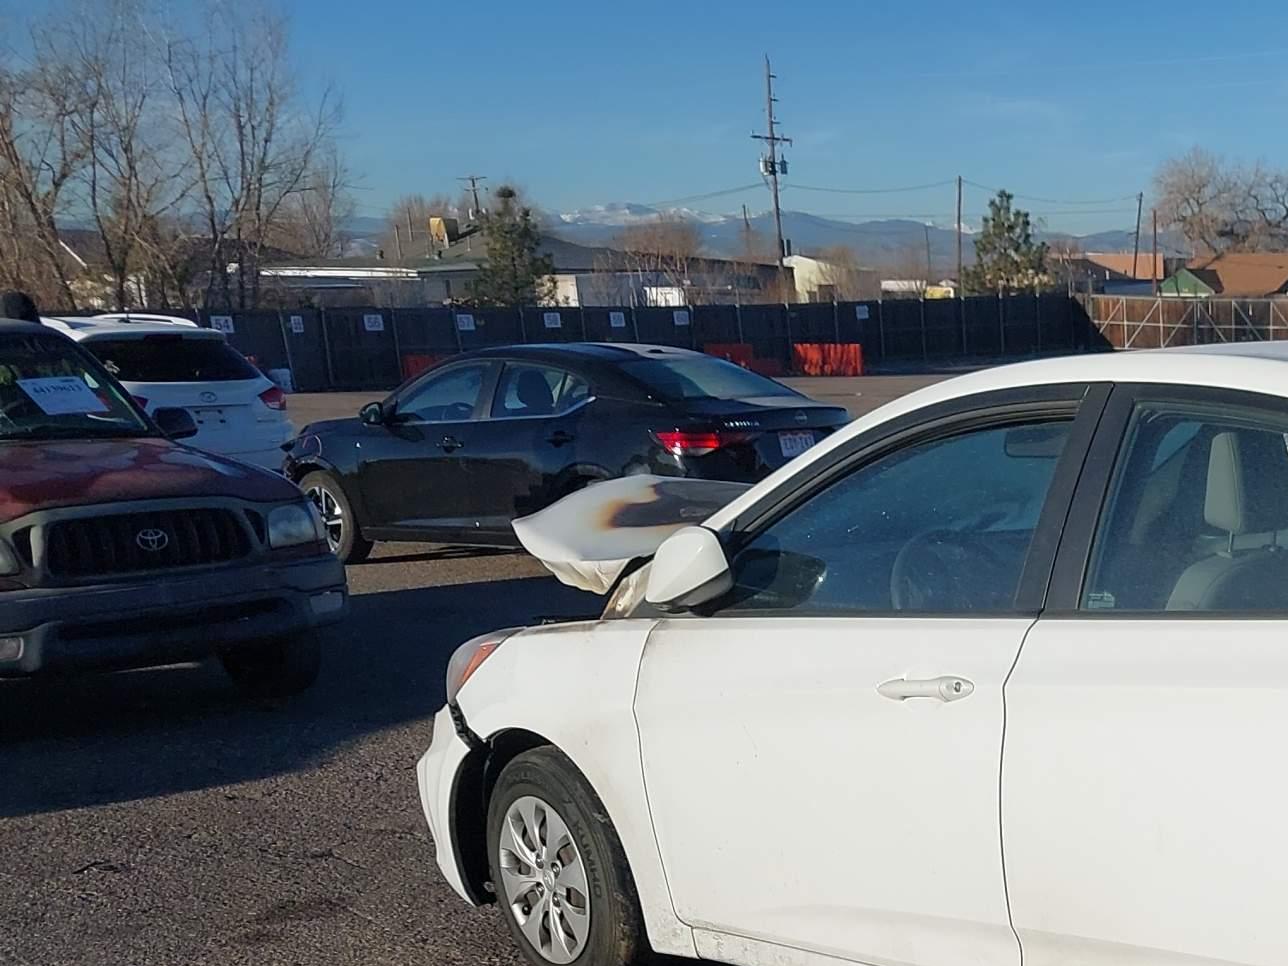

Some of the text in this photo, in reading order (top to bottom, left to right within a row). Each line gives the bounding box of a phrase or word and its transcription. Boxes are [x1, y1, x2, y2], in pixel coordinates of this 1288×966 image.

[214, 317, 231, 331] 54
[366, 316, 381, 328] 56
[458, 316, 473, 328] 57
